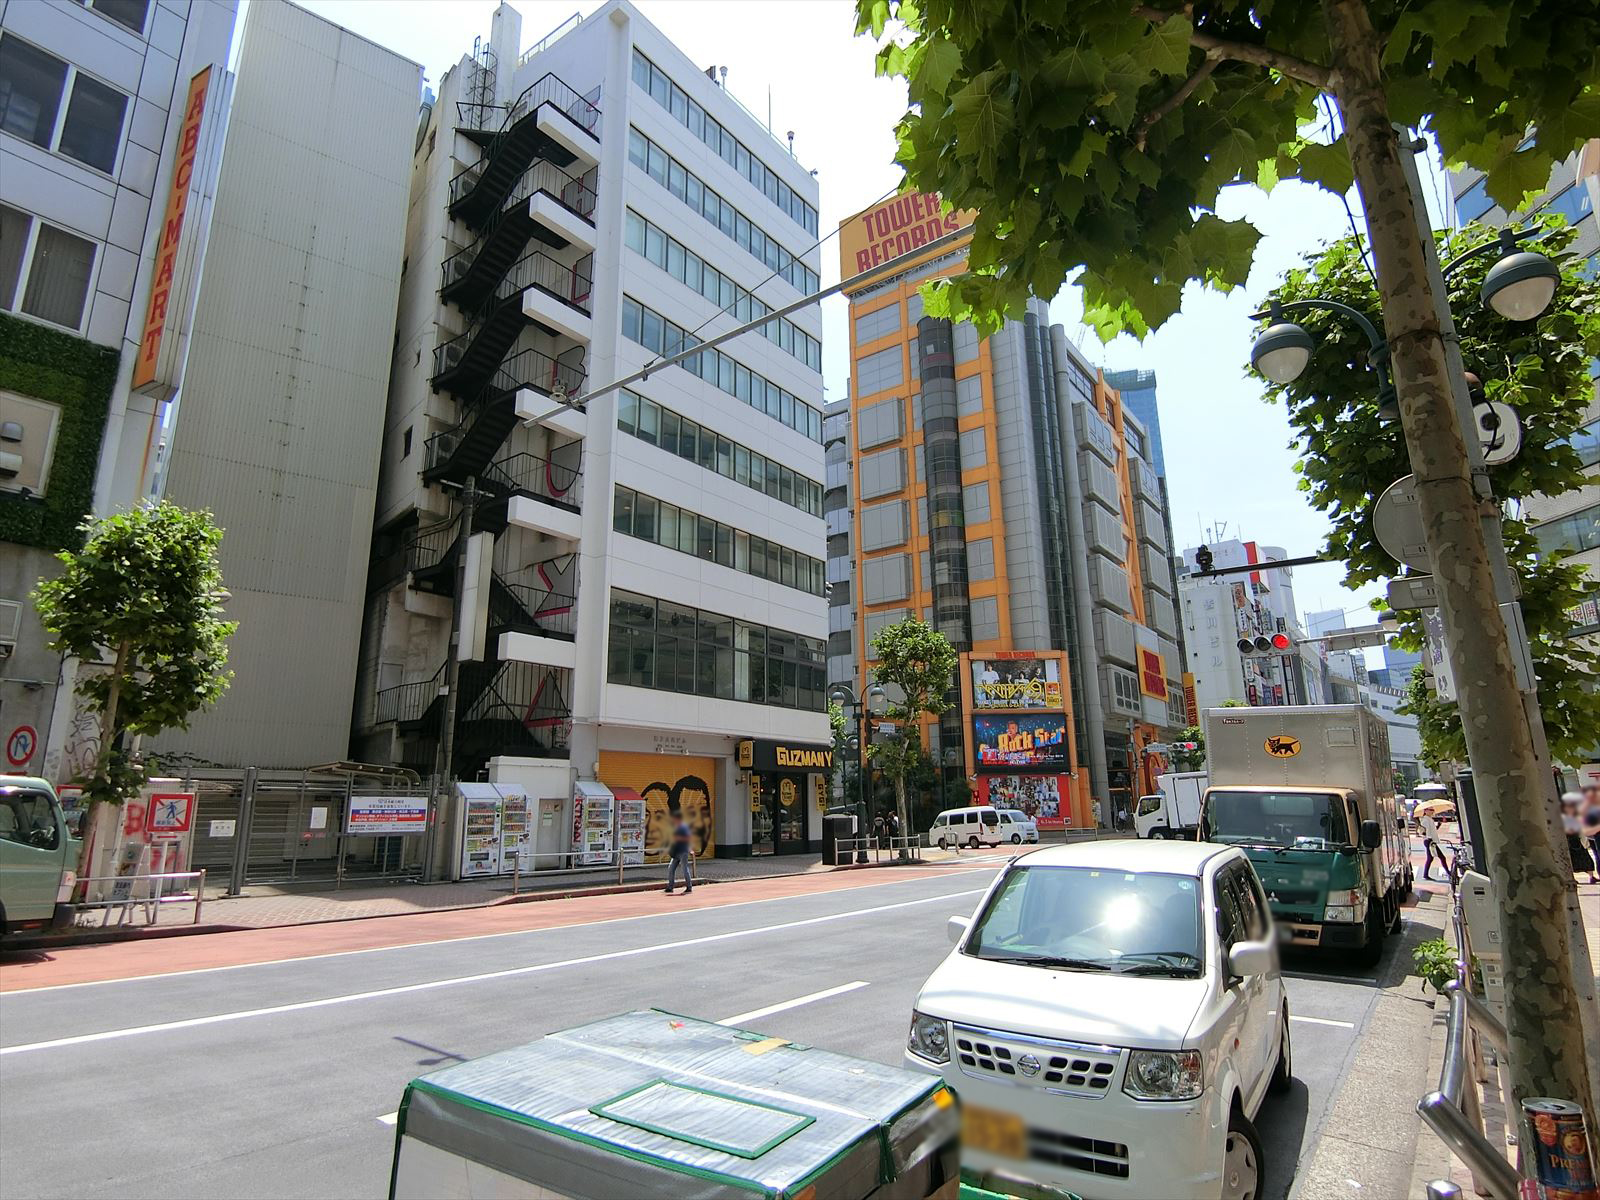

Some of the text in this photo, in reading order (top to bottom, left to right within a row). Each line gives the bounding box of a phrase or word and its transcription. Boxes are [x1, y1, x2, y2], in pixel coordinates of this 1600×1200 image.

[145, 88, 205, 363] ABC-MART
[855, 211, 961, 273] RECORDS
[862, 191, 942, 243] TOWER
[776, 746, 833, 768] GUZMAN Y
[998, 725, 1066, 752] Rock Star
